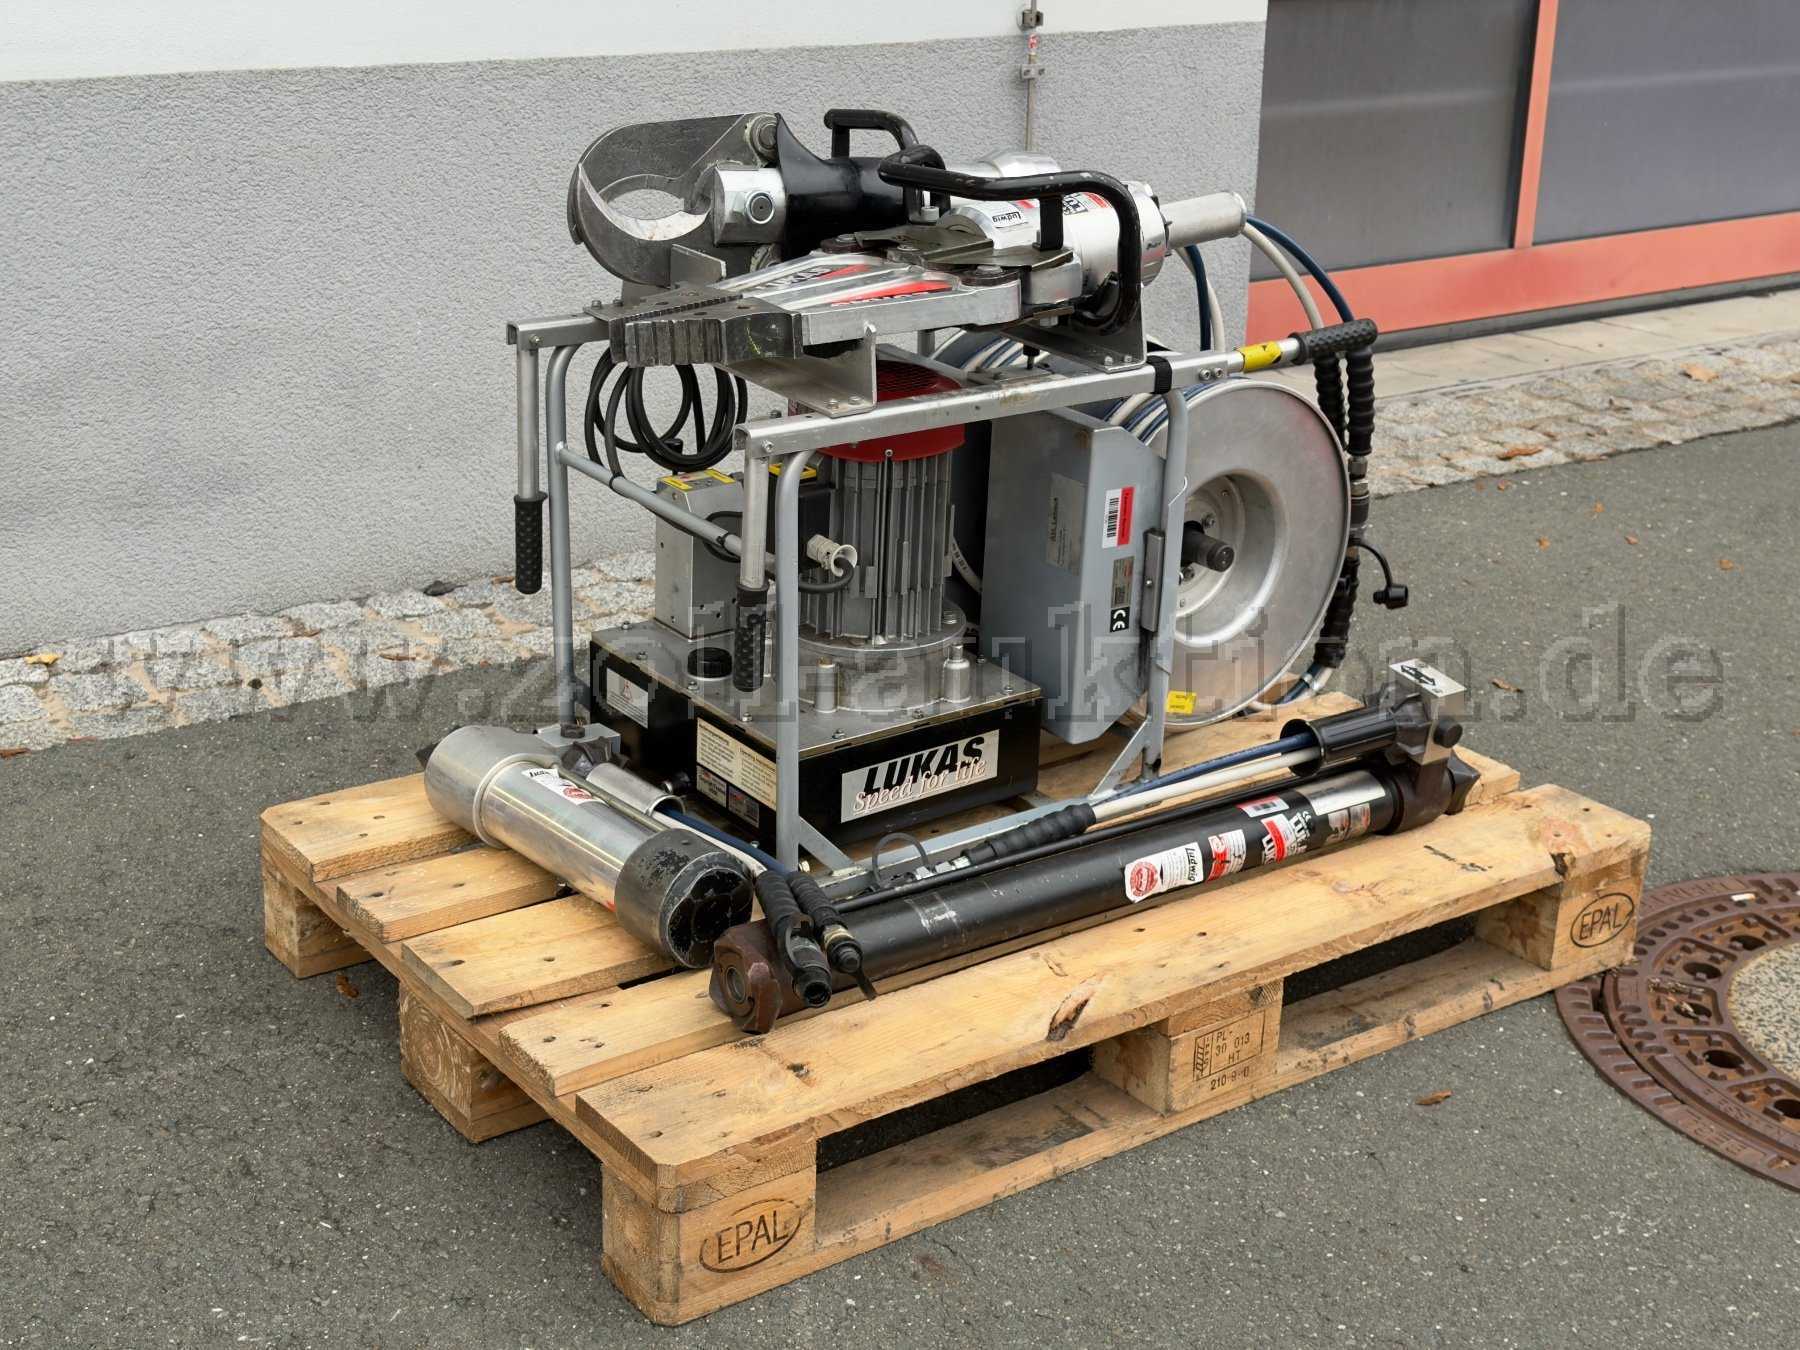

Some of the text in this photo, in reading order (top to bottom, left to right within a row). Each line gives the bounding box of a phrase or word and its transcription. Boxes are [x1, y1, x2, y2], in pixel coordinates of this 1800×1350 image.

[863, 737, 985, 792] LUKAS
[919, 770, 949, 797] for
[1578, 902, 1622, 941] EPAL
[717, 1211, 788, 1264] EPAL
